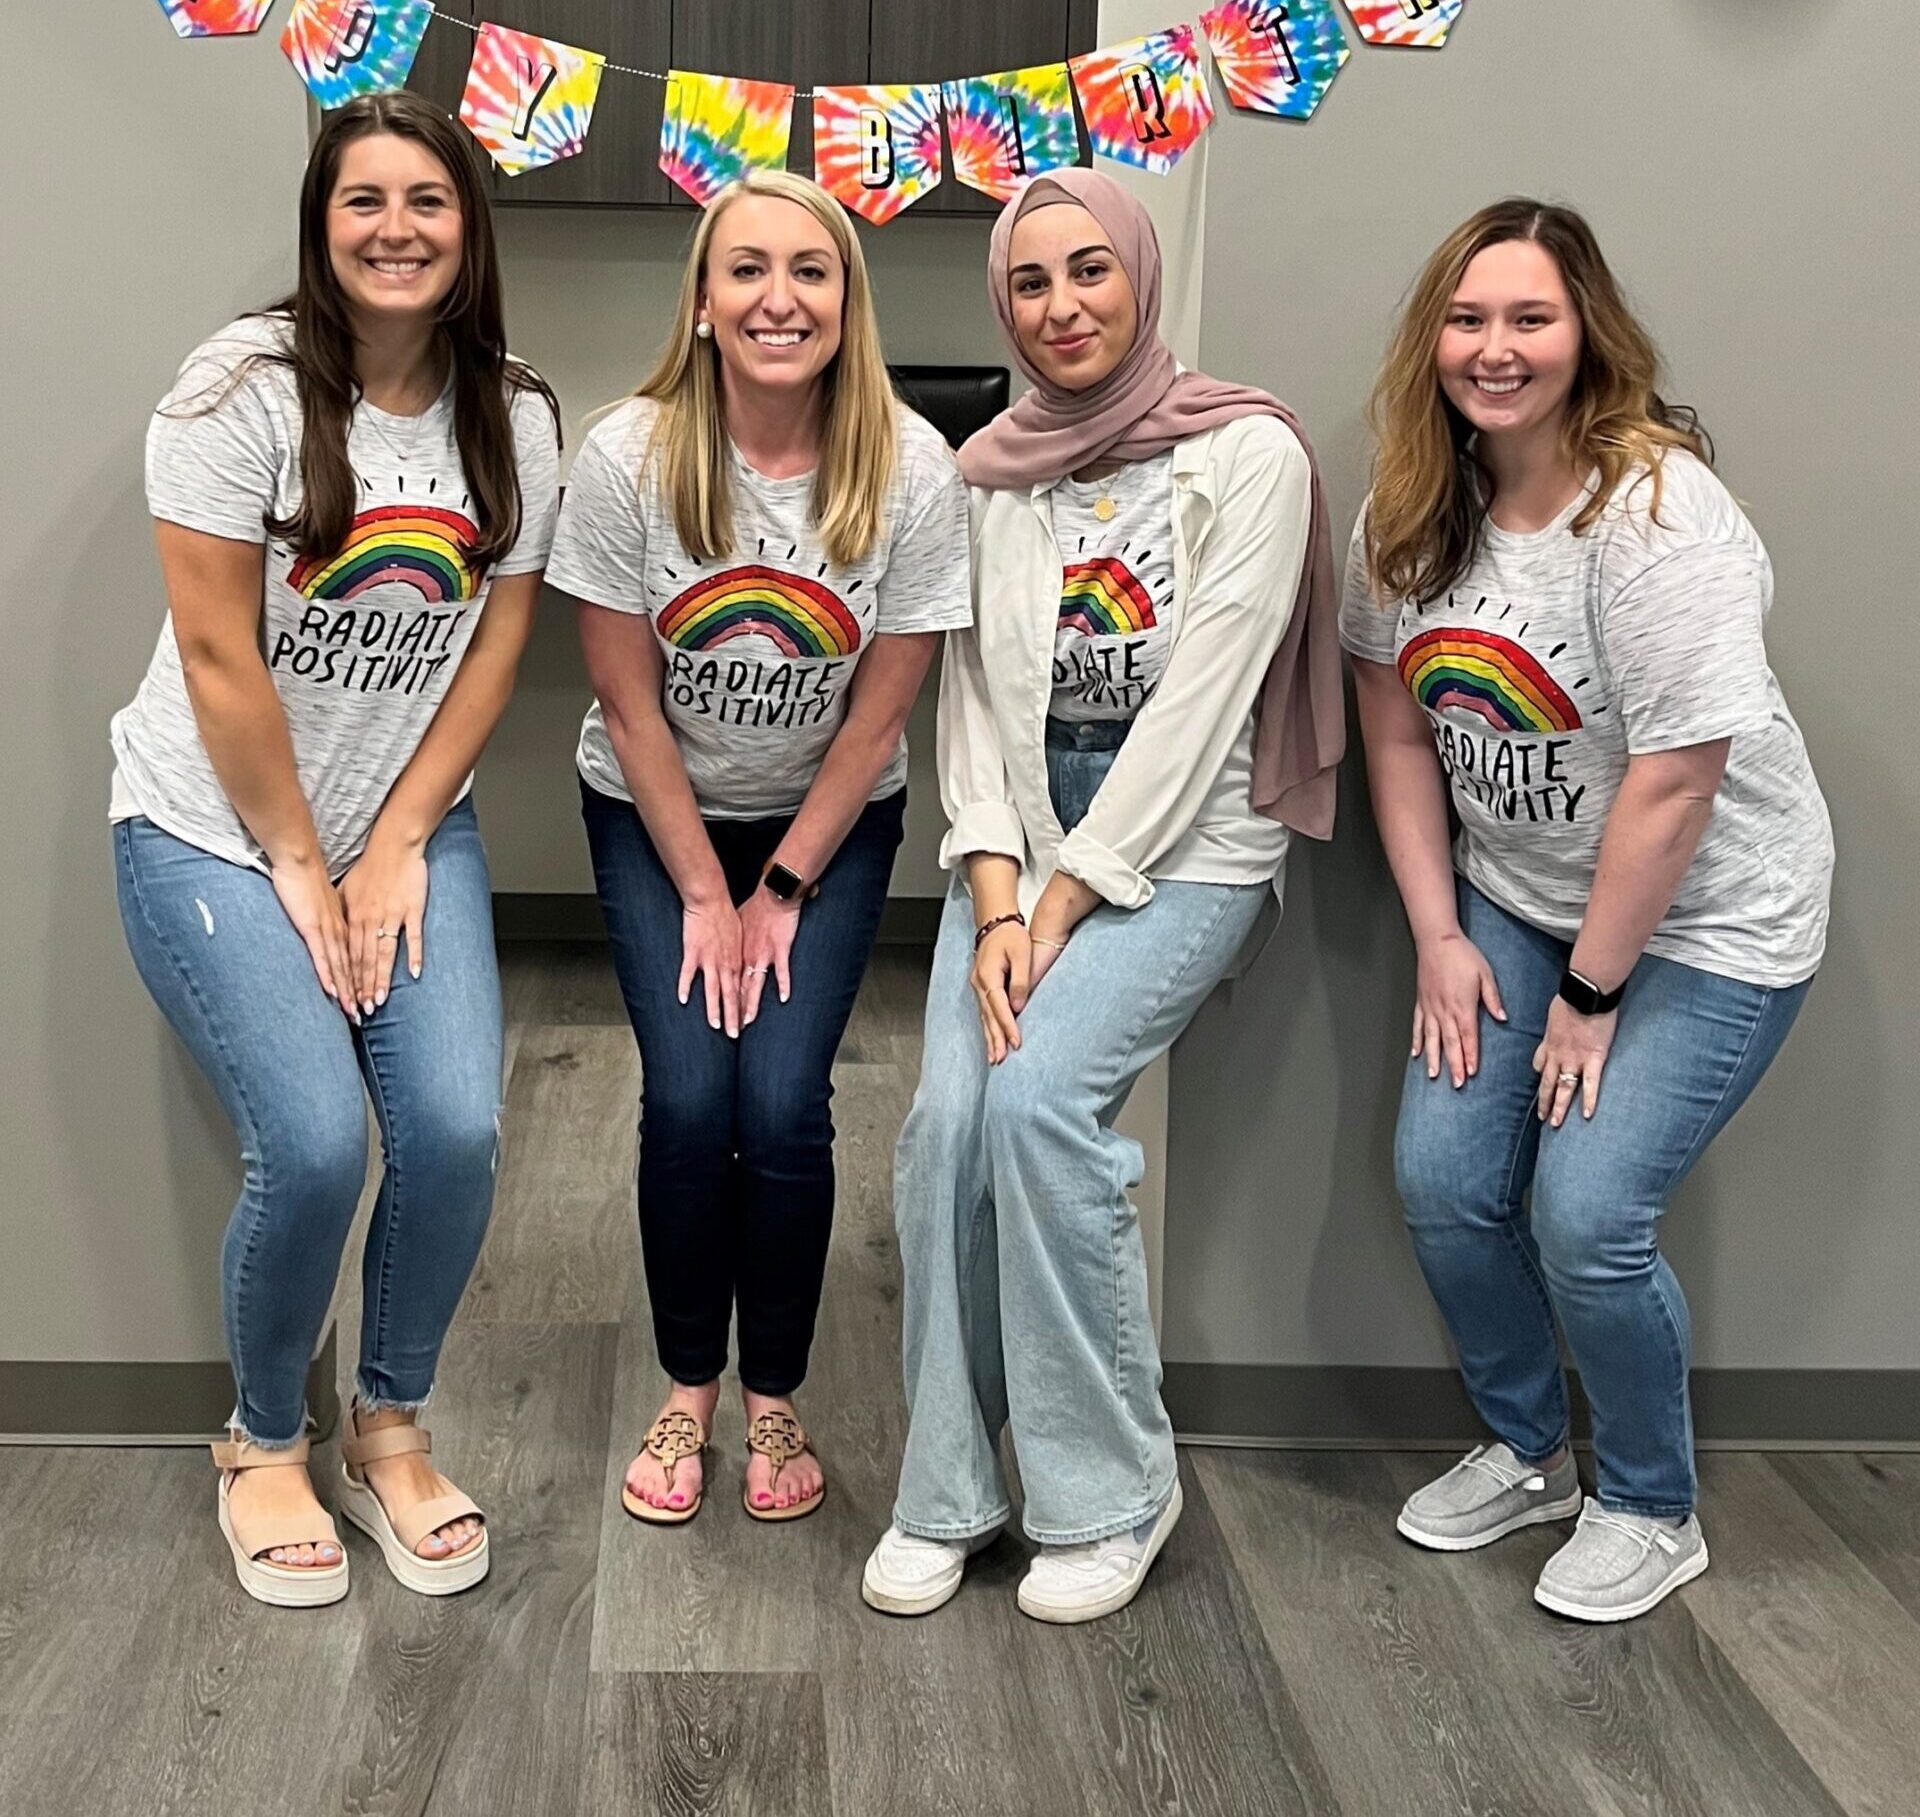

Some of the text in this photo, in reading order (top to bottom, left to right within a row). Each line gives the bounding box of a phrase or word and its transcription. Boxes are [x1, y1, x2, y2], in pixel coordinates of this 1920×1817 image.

[860, 0, 1440, 190] BIRT
[672, 651, 845, 700] RADIATE
[668, 679, 835, 729] OSITIVITY
